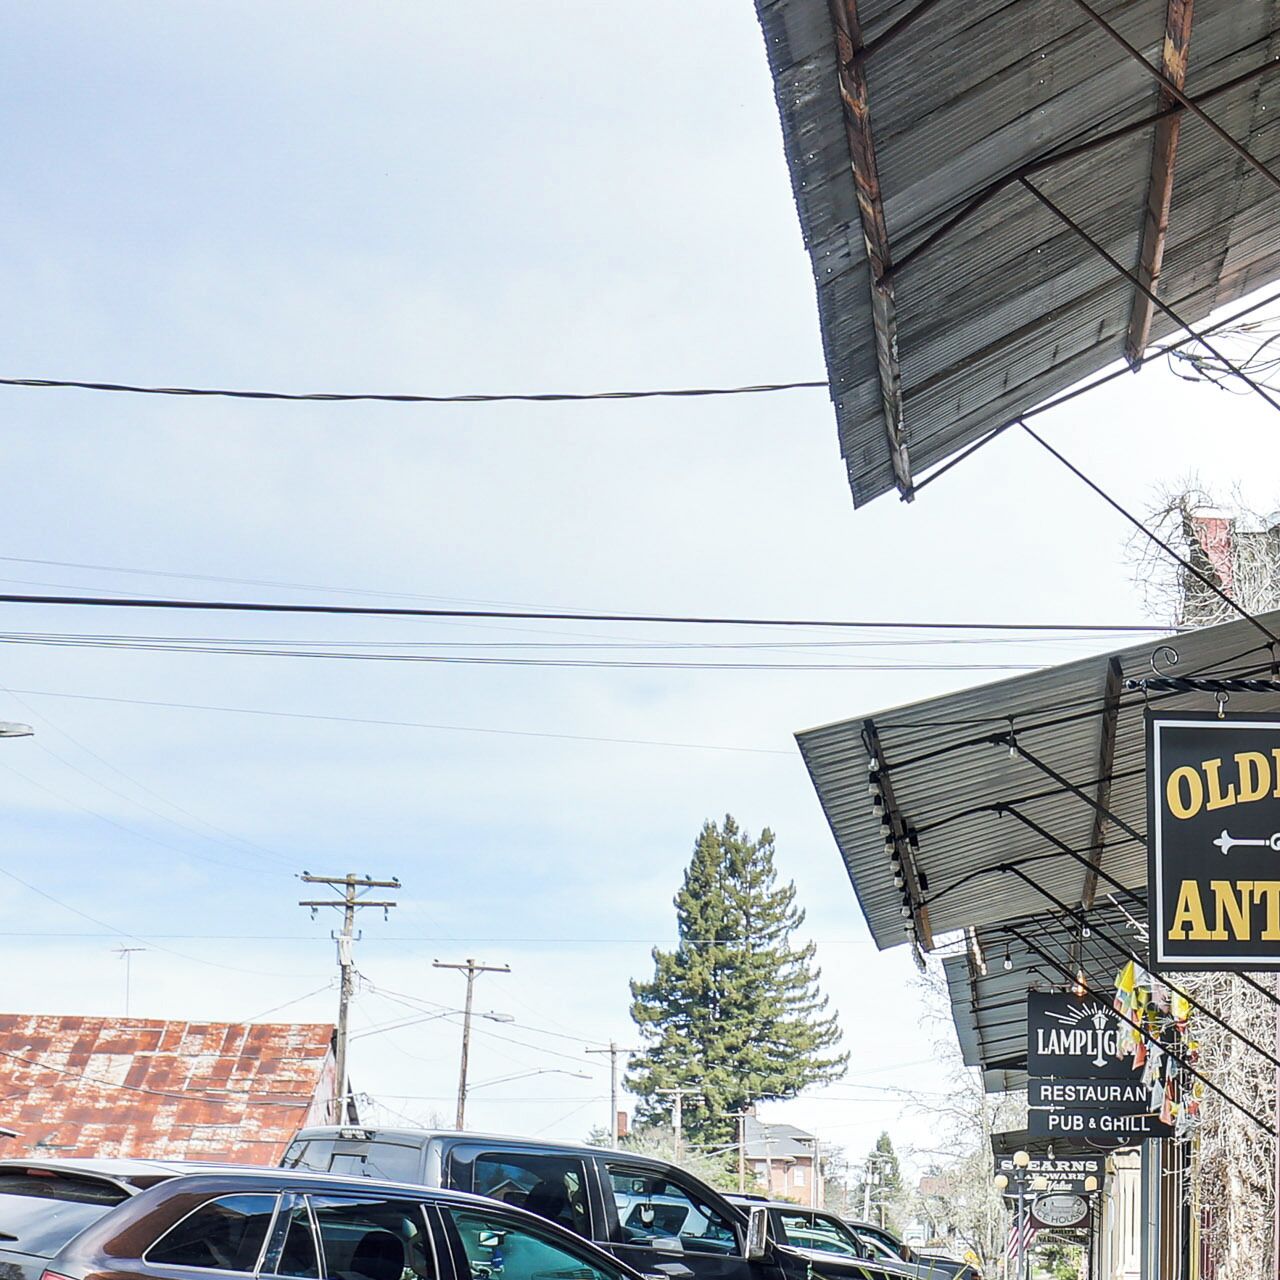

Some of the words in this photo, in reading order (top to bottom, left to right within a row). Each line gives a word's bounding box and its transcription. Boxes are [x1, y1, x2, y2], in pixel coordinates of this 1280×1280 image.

[1040, 1085, 1148, 1101] RESTAURAN
[1048, 1115, 1084, 1131] PUB
[1088, 1117, 1097, 1129] &
[1100, 1115, 1151, 1131] GRILL
[1051, 1207, 1085, 1224] HOUSE
